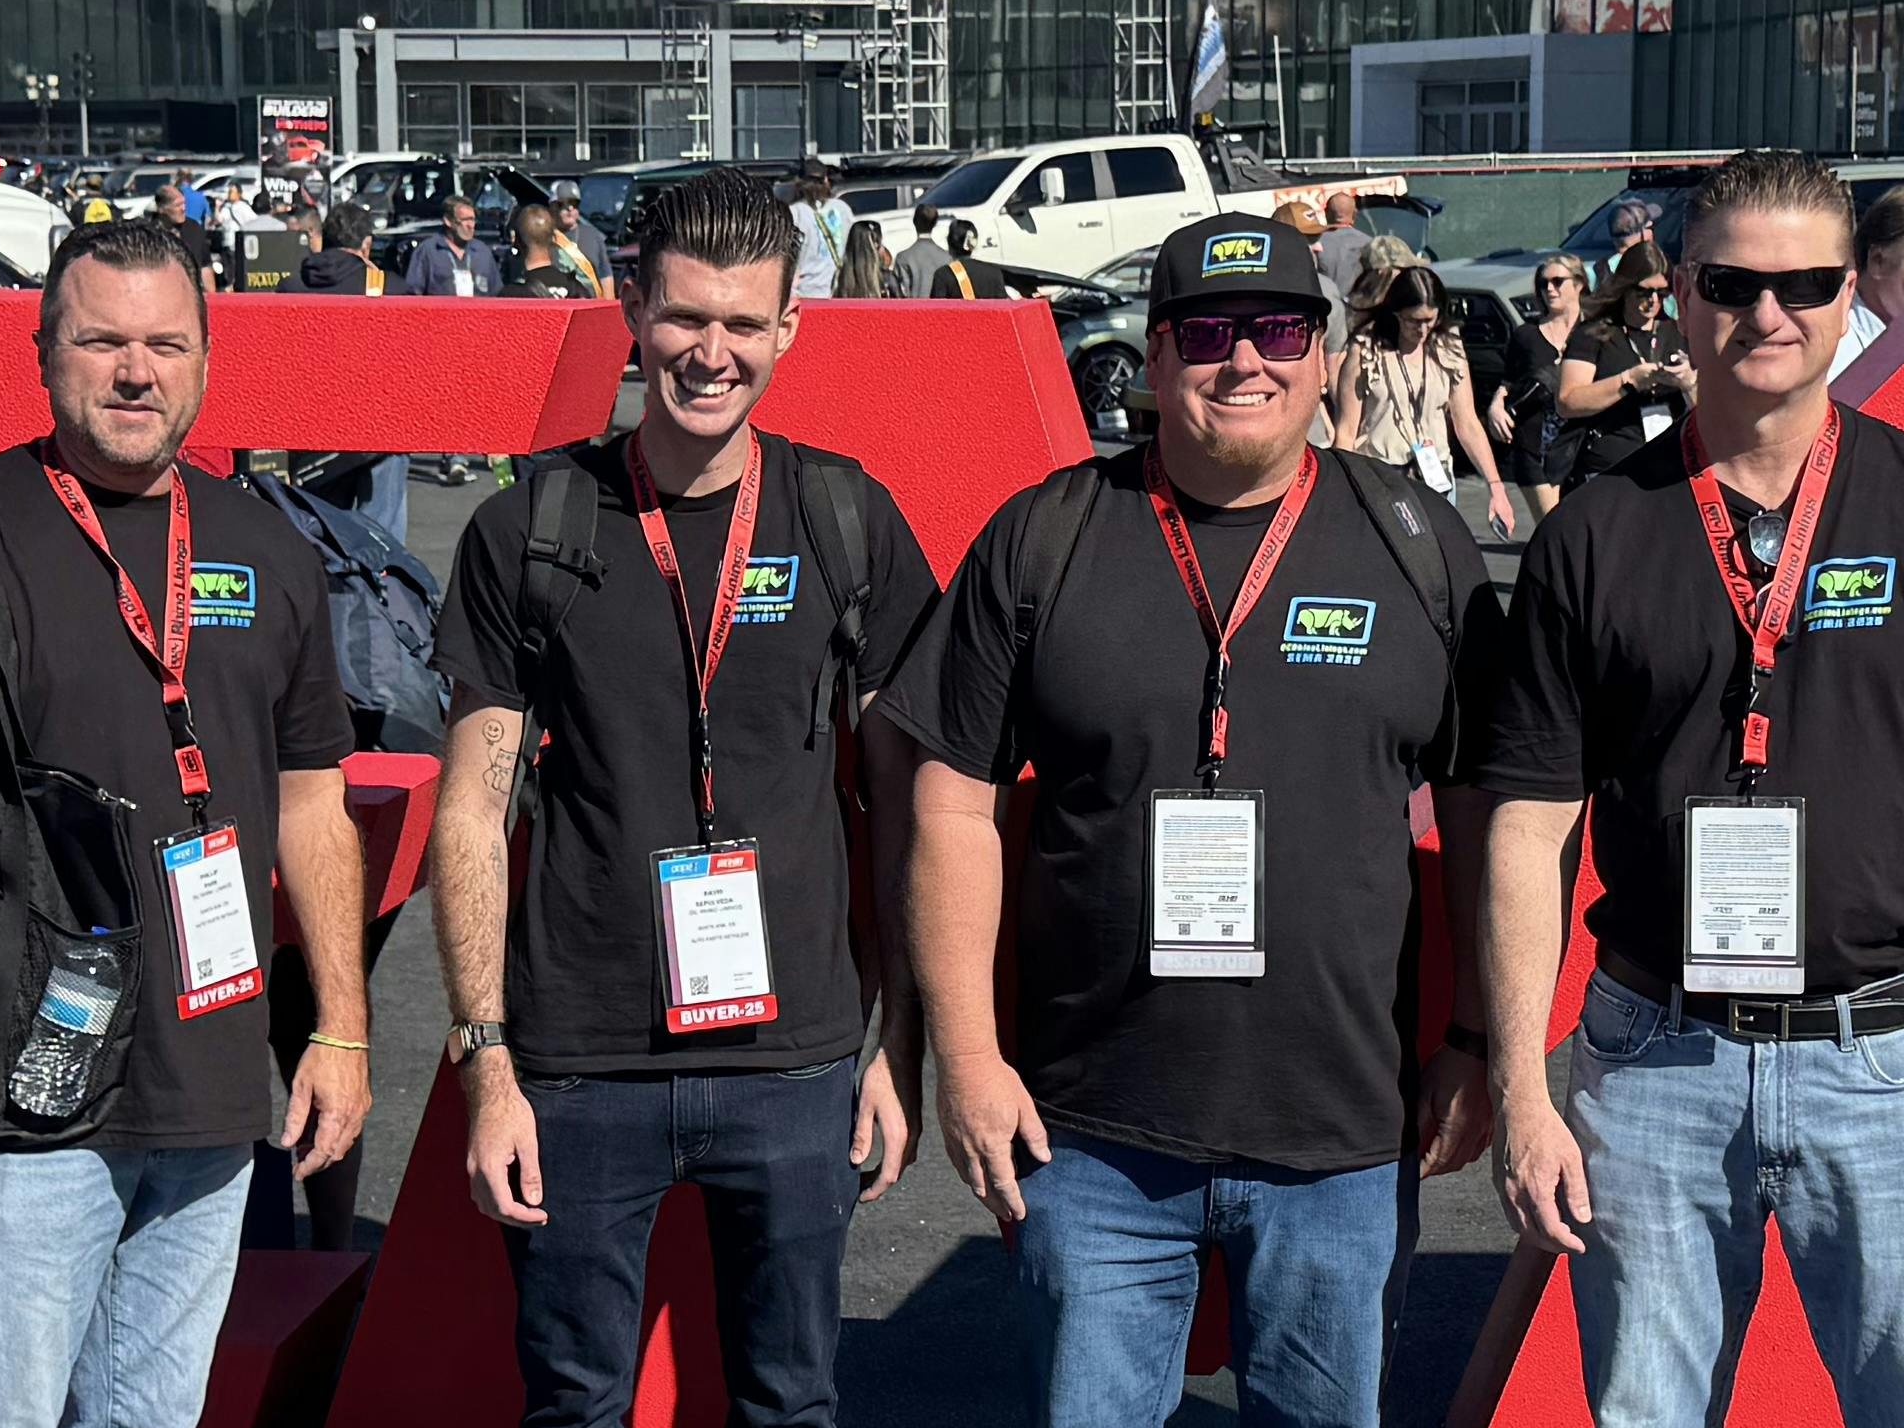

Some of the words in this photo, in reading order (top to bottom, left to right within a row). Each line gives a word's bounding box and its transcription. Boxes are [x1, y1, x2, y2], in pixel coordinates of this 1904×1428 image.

[1778, 554, 1800, 599] Rhino
[1796, 495, 1817, 552] Linings
[712, 603, 731, 650] Rhino
[724, 545, 745, 603] Linings
[188, 974, 255, 1012] BUYER-25
[680, 1000, 766, 1026] BUYER-25
